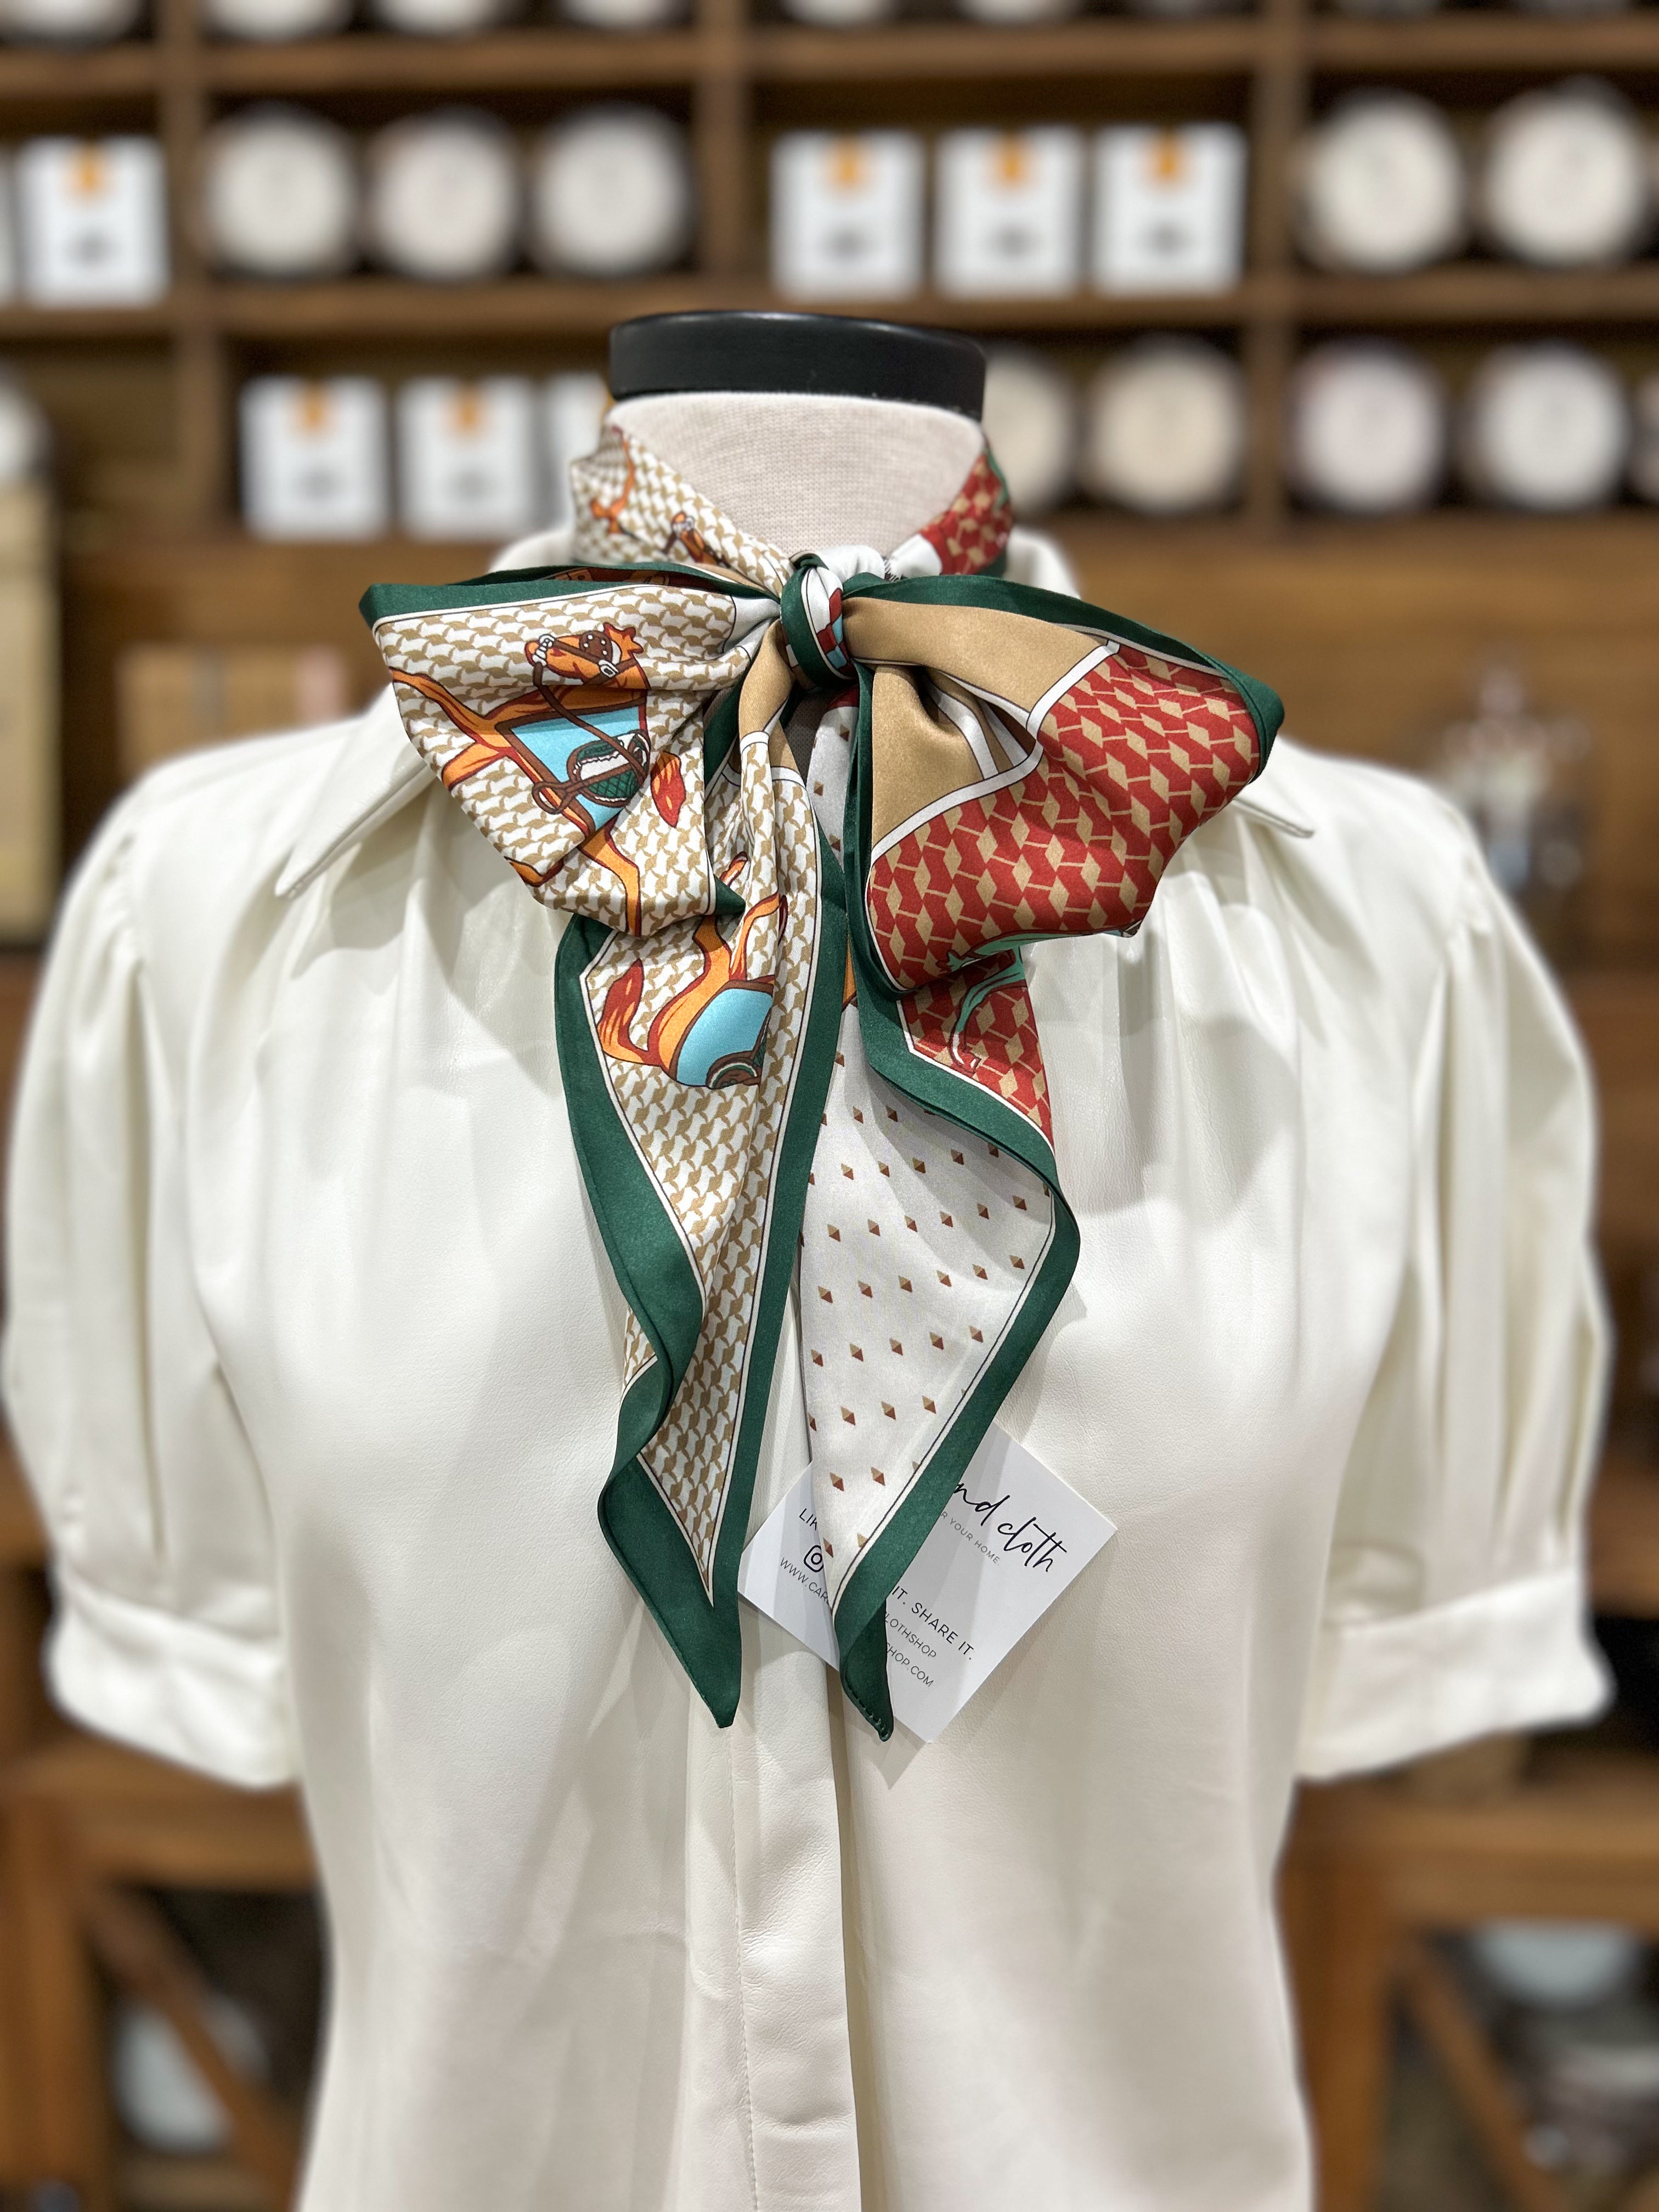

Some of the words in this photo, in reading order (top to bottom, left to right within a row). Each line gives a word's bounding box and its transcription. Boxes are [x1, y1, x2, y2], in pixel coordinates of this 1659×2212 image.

[950, 1517, 973, 1541] YOUR
[974, 1540, 1000, 1566] HOME.
[953, 1483, 1011, 1526] nd
[997, 1516, 1067, 1572] cloth
[799, 1508, 817, 1531] LIK
[892, 1585, 908, 1605] IT.
[911, 1602, 959, 1644] SHARE
[958, 1641, 974, 1660] IT.
[885, 1611, 937, 1658] LOTHSHOP
